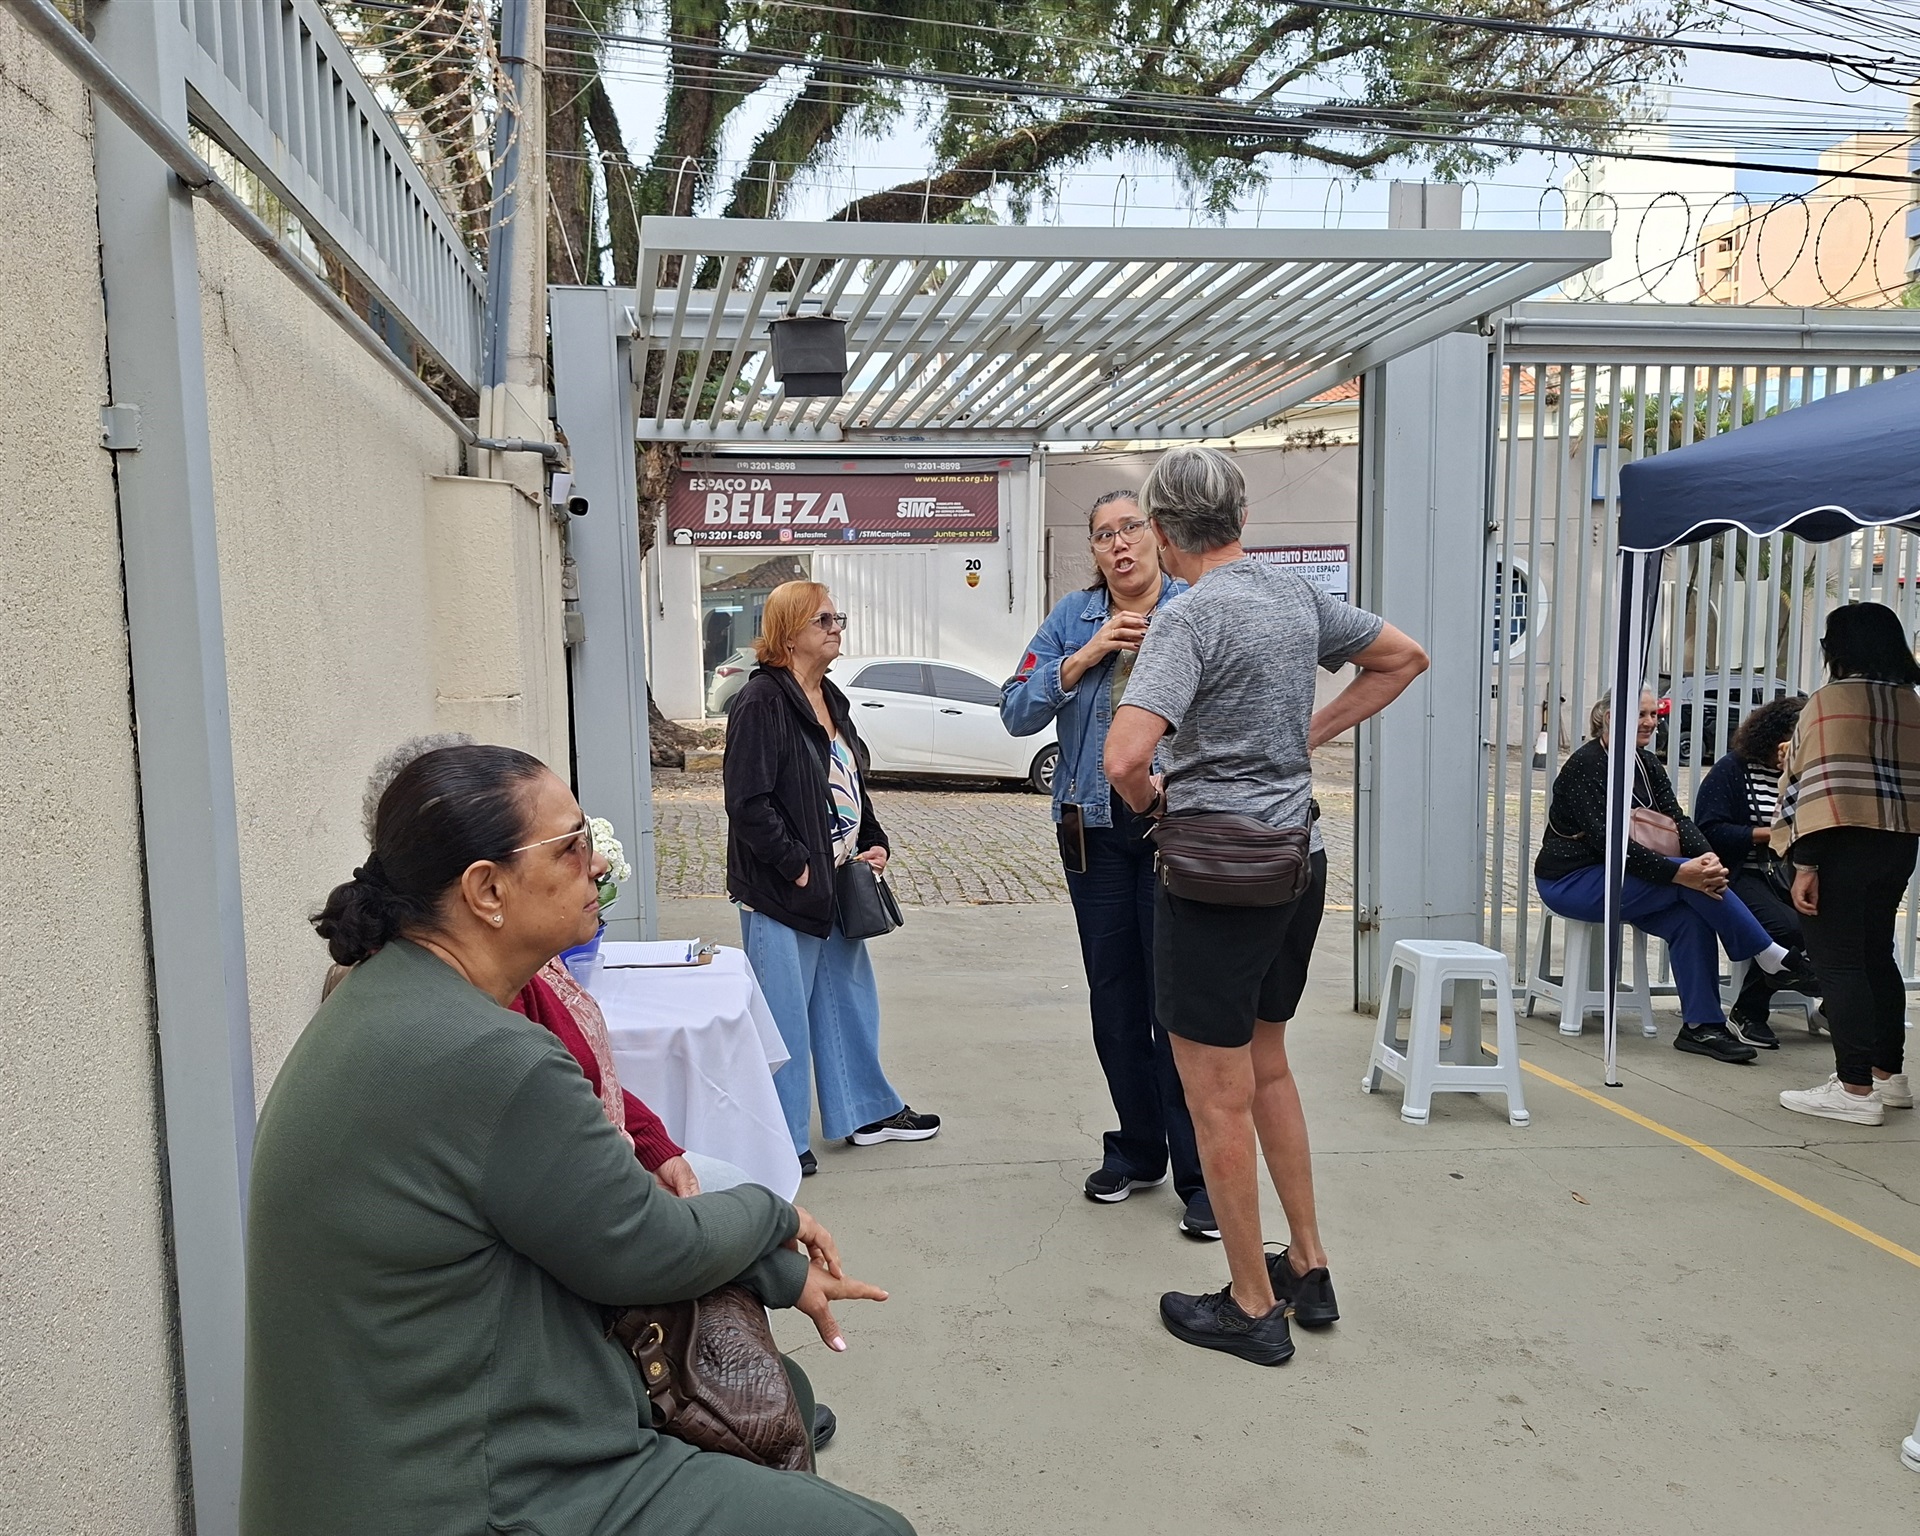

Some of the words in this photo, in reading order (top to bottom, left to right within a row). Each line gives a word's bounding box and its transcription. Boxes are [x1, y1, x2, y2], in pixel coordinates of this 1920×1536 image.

[750, 462, 796, 470] 3201-8898
[917, 462, 961, 470] 3201-8898
[915, 475, 993, 484] www.stmc.org.br
[689, 478, 747, 494] ESPAÇO
[750, 478, 772, 491] DA
[704, 493, 850, 524] BELEZA
[896, 497, 936, 518] STMC
[693, 532, 708, 540] (19)
[708, 531, 762, 540] 3201-8898
[859, 530, 911, 539] /STMCampinas
[933, 530, 969, 538] Junte-se
[1243, 551, 1300, 563] ACIONAMENTO
[1302, 549, 1345, 562] EXCLUSIVO
[965, 558, 982, 571] 20
[1316, 564, 1341, 574] ESPAÇO
